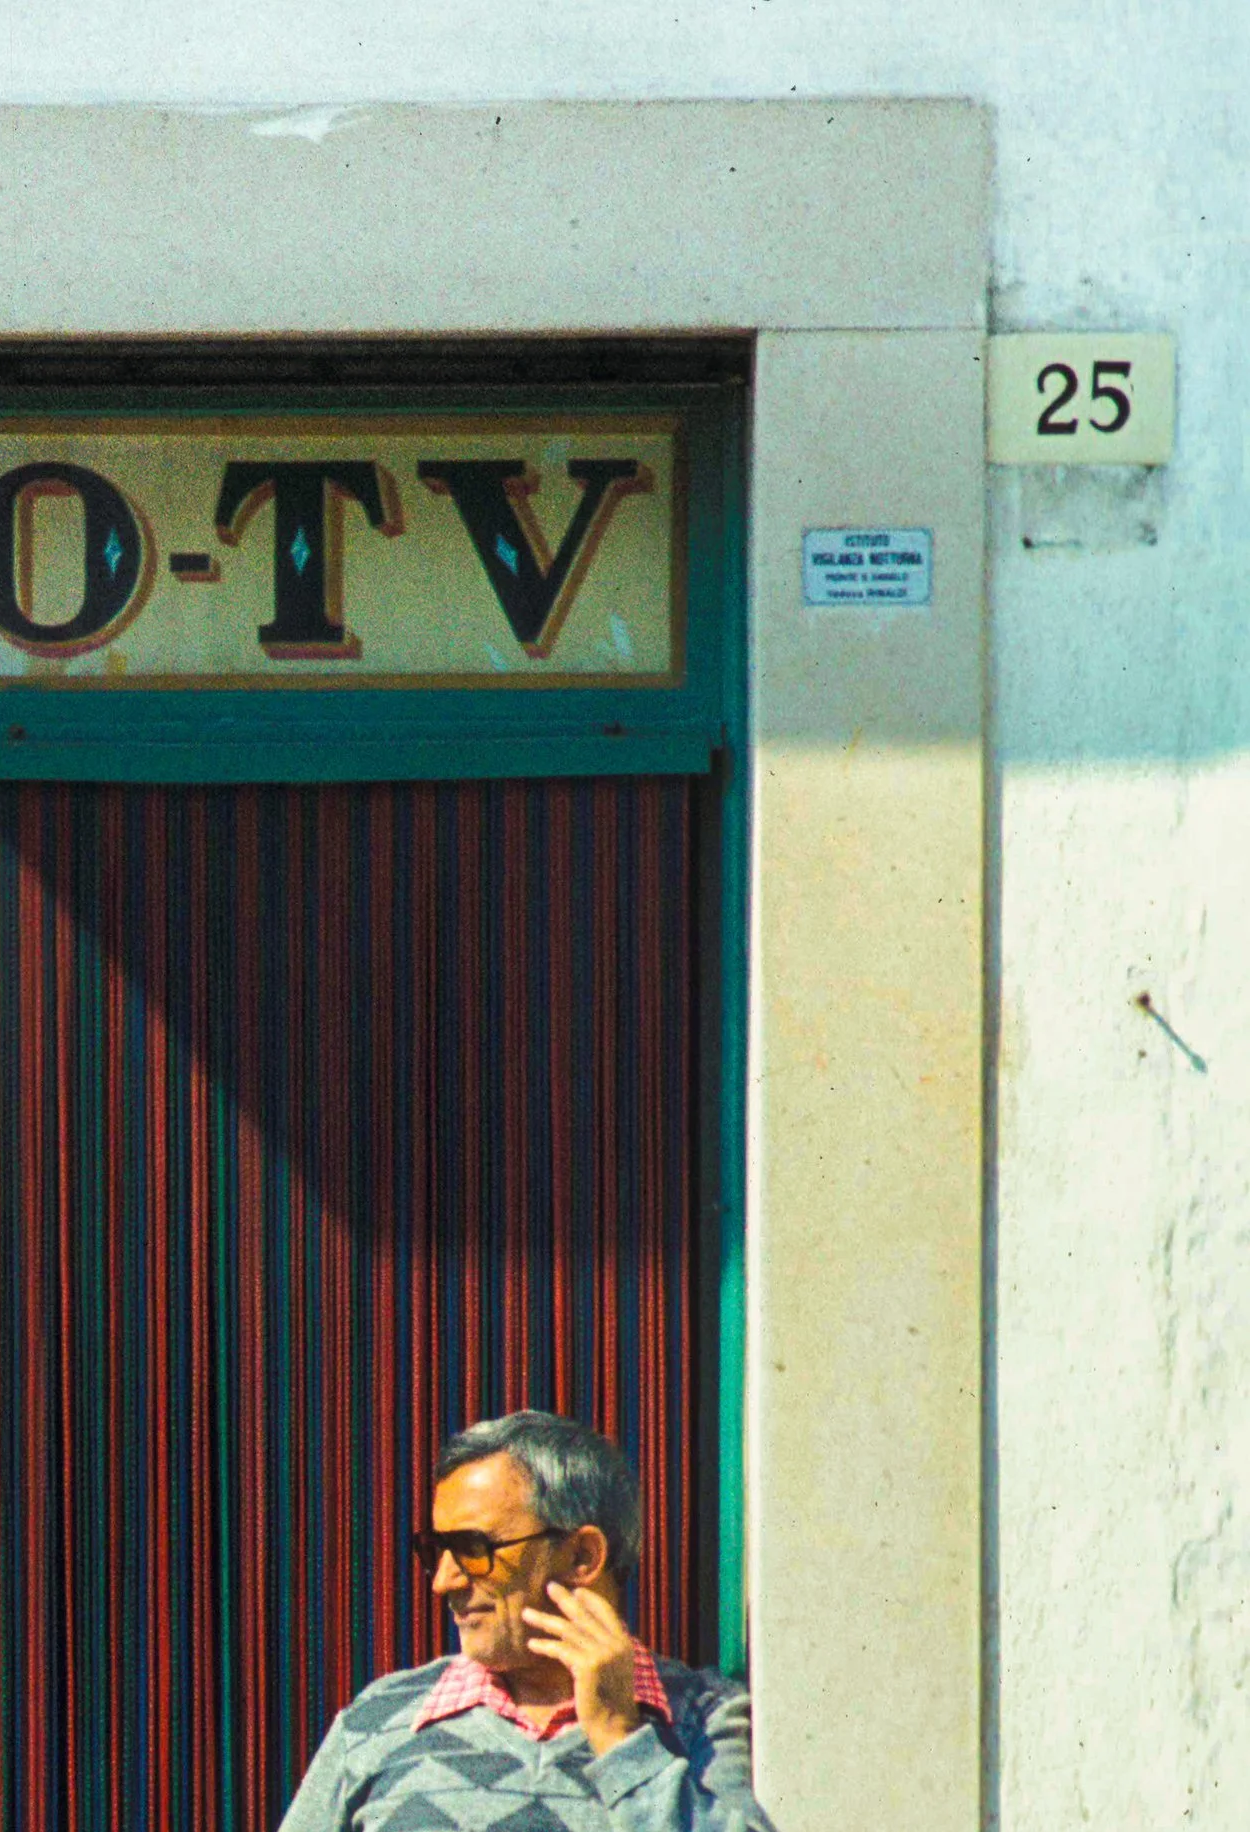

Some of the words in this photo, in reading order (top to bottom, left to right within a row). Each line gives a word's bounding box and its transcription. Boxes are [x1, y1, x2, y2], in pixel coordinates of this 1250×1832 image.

[1036, 360, 1132, 435] 25
[844, 534, 890, 547] ISTITUTO
[811, 552, 864, 566] VIGILANZA
[869, 552, 923, 565] NOTTURNA
